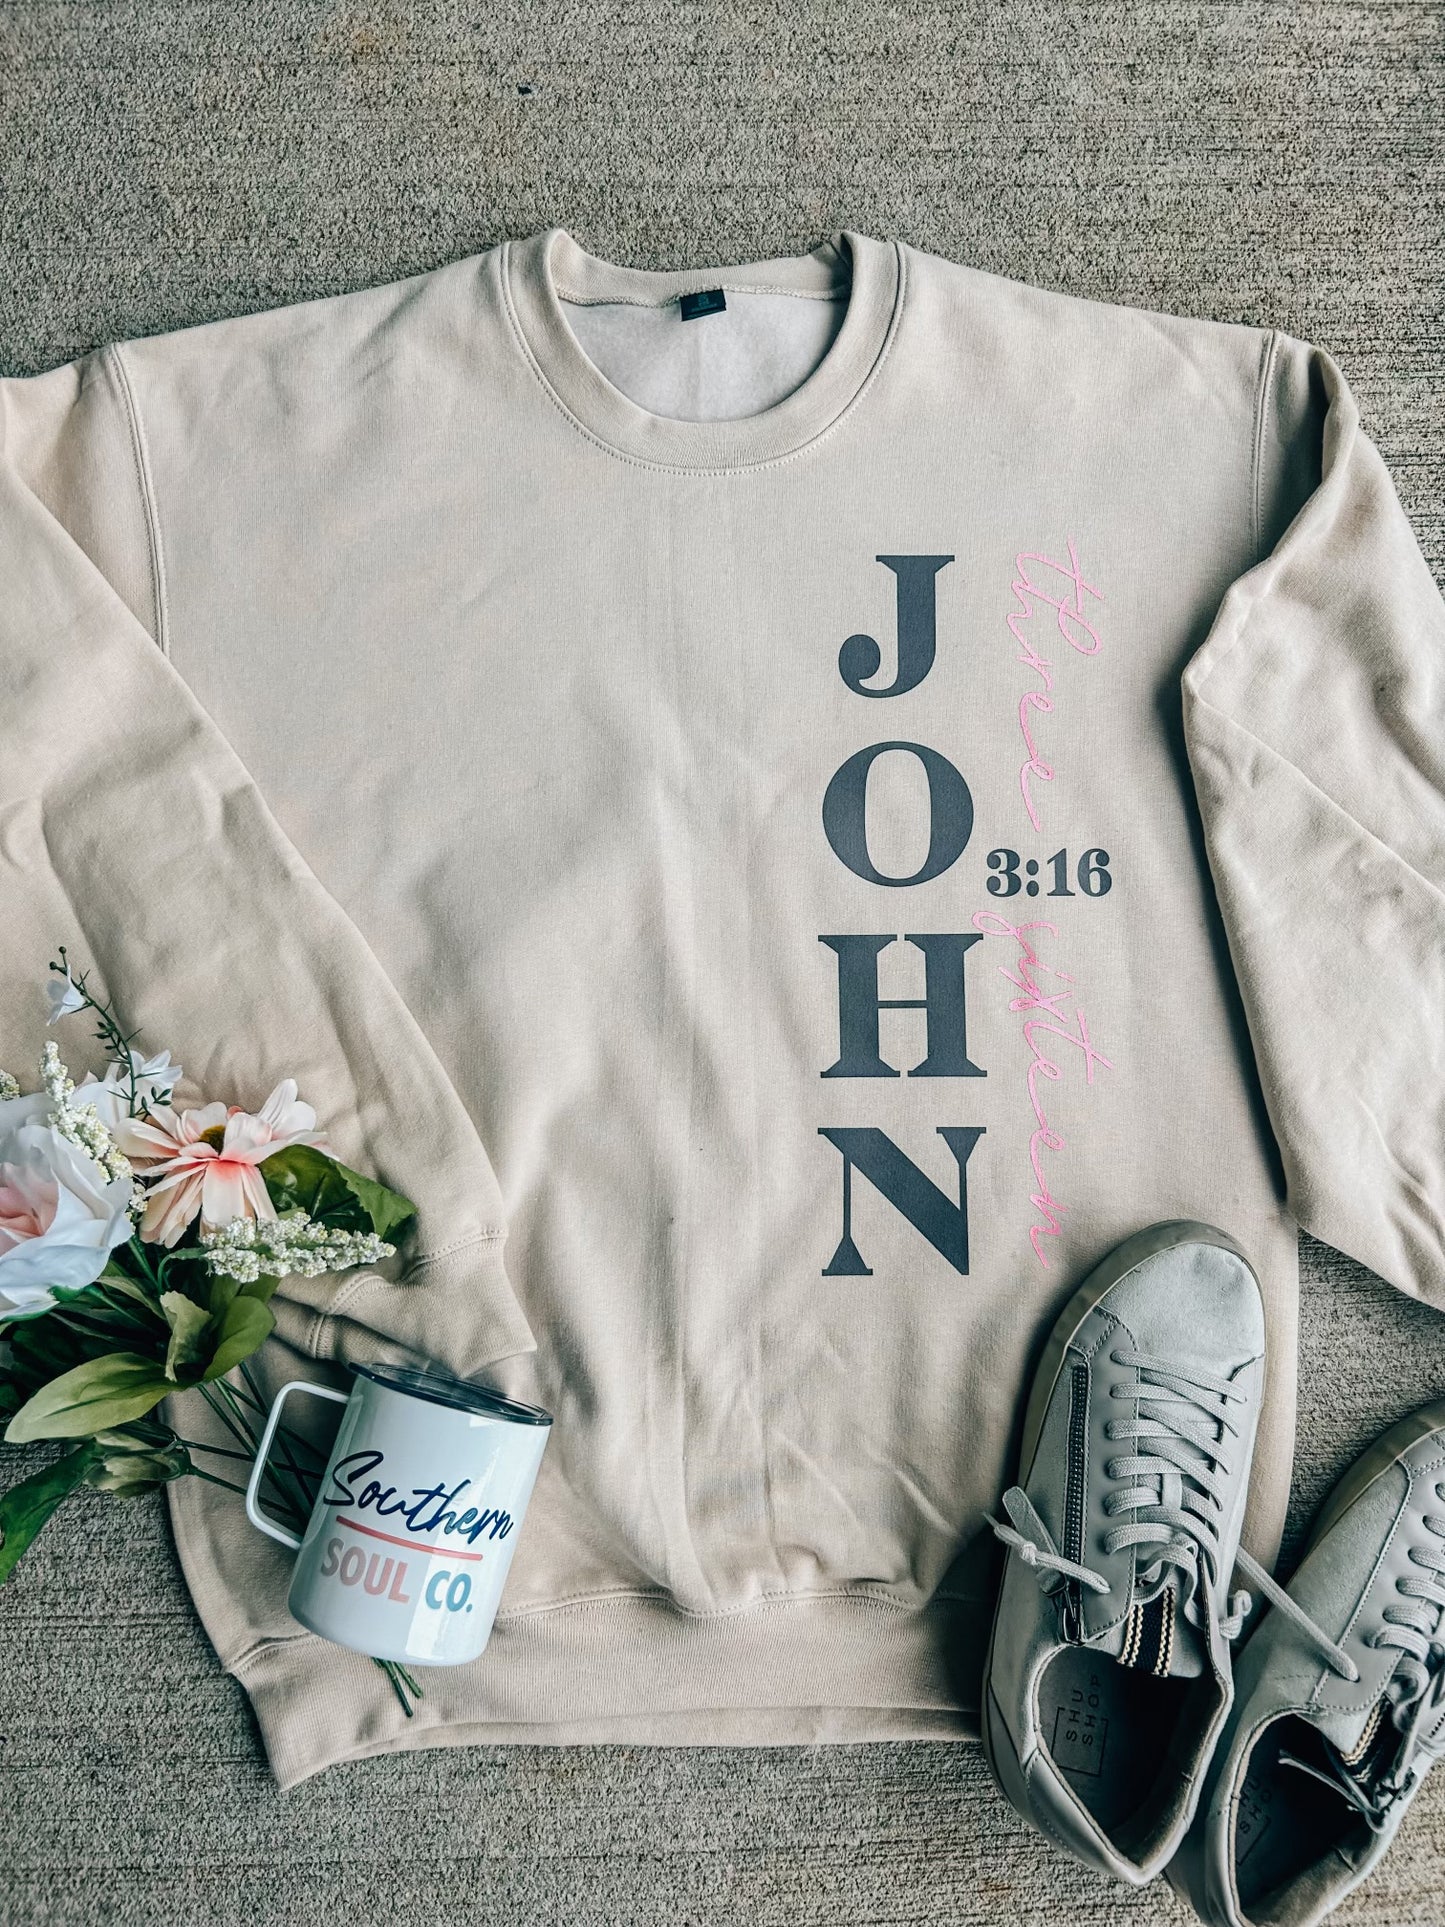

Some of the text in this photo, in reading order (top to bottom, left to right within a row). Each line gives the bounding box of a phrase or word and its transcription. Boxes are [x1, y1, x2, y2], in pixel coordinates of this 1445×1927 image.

[1006, 534, 1104, 832] three
[986, 848, 1113, 898] 3:16
[818, 555, 987, 1276] JOHN
[972, 910, 1114, 1269] sixteen
[323, 1450, 514, 1545] Southern
[320, 1537, 473, 1613] SOUL CO.
[1066, 1689, 1083, 1742] SHU
[1082, 1674, 1101, 1746] SHOP
[1239, 1788, 1273, 1835] SHO
